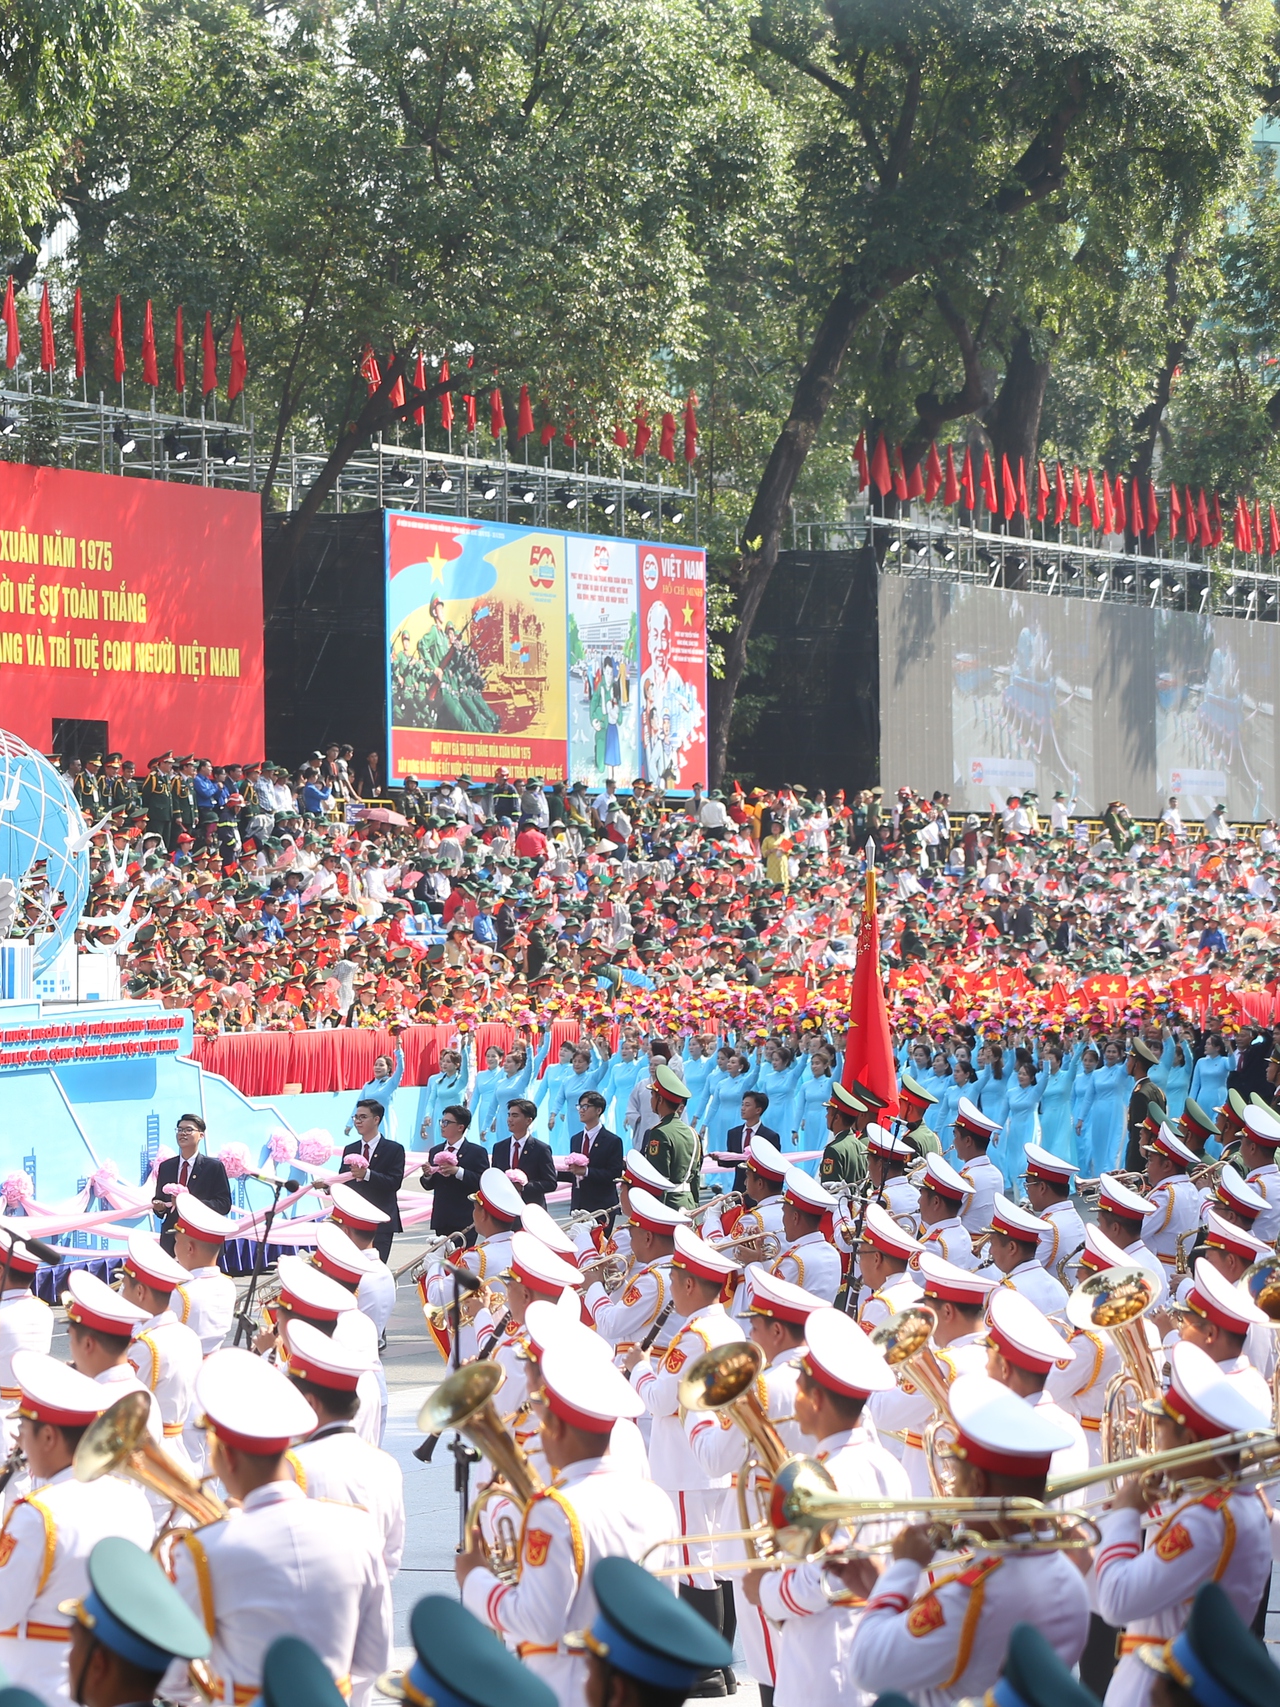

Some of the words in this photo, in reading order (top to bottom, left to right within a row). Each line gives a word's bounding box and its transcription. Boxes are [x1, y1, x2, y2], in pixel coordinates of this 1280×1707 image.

[0, 525, 39, 564] XUÂN
[43, 529, 76, 568] NĂM
[80, 539, 113, 572] 1975
[660, 553, 682, 582] VIỆT
[683, 559, 704, 580] NAM
[18, 574, 36, 615] VỀ
[39, 582, 61, 623] SỰ
[62, 582, 98, 620] TOÀN
[102, 580, 147, 623] THẮNG
[662, 581, 673, 594] HỒ
[673, 584, 685, 596] CHÍ
[26, 628, 46, 667] VÀ
[48, 631, 71, 668] TRÍ
[74, 633, 99, 677] TUỆ
[103, 639, 132, 672] CON
[135, 636, 176, 674] NGƯỜI
[179, 639, 207, 682] VIỆT
[210, 646, 240, 677] NAM
[5, 1025, 31, 1043] NƯỚC
[31, 1023, 61, 1040] NGOÀI
[62, 1022, 73, 1037] LÀ
[75, 1022, 88, 1038] BỘ
[89, 1020, 113, 1037] PHẬN
[114, 1018, 146, 1034] KHÔNG
[146, 1016, 168, 1030] TÁCH
[169, 1014, 185, 1029] RỜI
[12, 1050, 30, 1065] LỰC
[30, 1046, 49, 1062] CỦA
[49, 1045, 74, 1062] CỘNG
[75, 1041, 102, 1058] ĐỒNG
[103, 1041, 122, 1055] DÂN
[123, 1040, 139, 1057] TỘC
[140, 1038, 159, 1053] VIỆT
[159, 1038, 179, 1051] NAM
